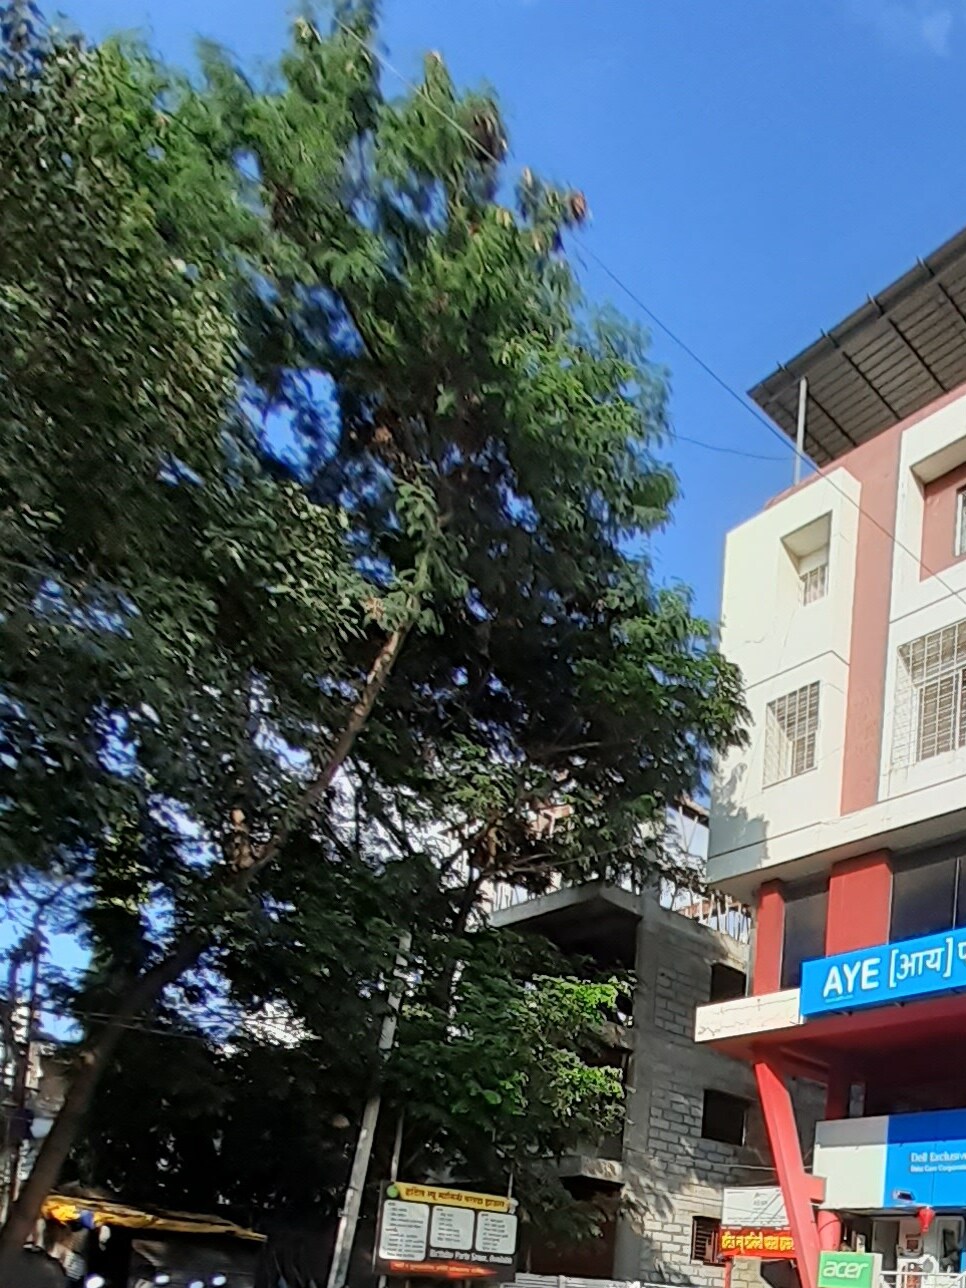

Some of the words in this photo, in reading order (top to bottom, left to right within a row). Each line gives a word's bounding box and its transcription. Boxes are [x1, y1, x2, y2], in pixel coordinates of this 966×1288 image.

[823, 957, 881, 998] AYE
[910, 1152, 928, 1162] Dell
[823, 1260, 869, 1279] acer
